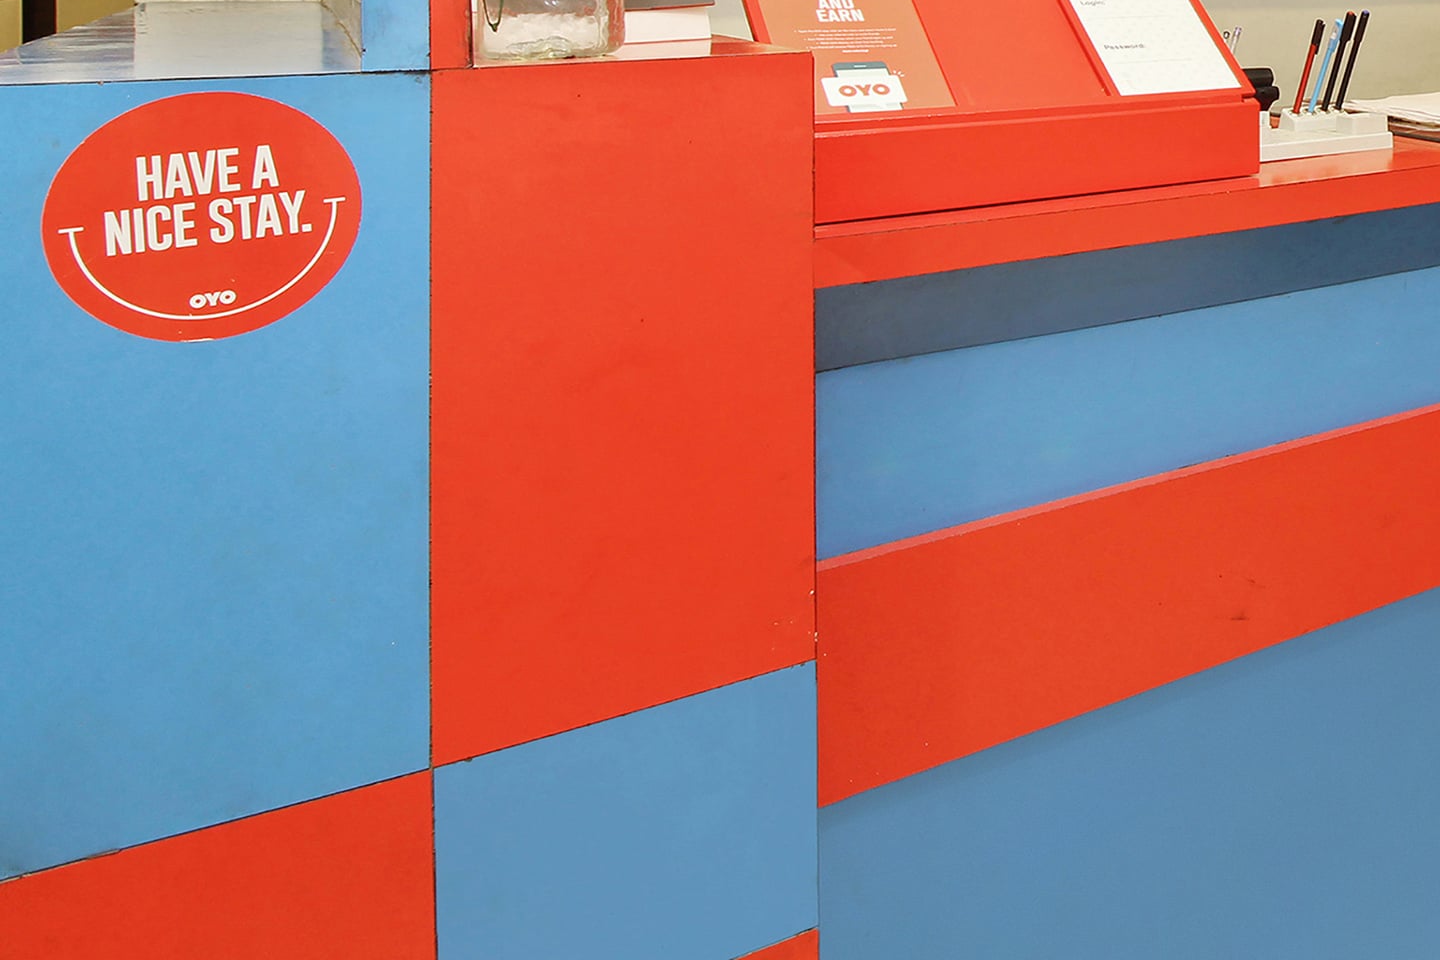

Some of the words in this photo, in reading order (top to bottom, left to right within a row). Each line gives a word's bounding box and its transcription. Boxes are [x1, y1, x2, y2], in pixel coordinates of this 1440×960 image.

[816, 9, 865, 23] EARN
[838, 84, 891, 97] OYO
[135, 147, 242, 202] HAVE
[252, 144, 280, 189] A
[103, 202, 198, 257] NICE
[208, 190, 313, 244] STAY.
[189, 290, 237, 309] OYO
